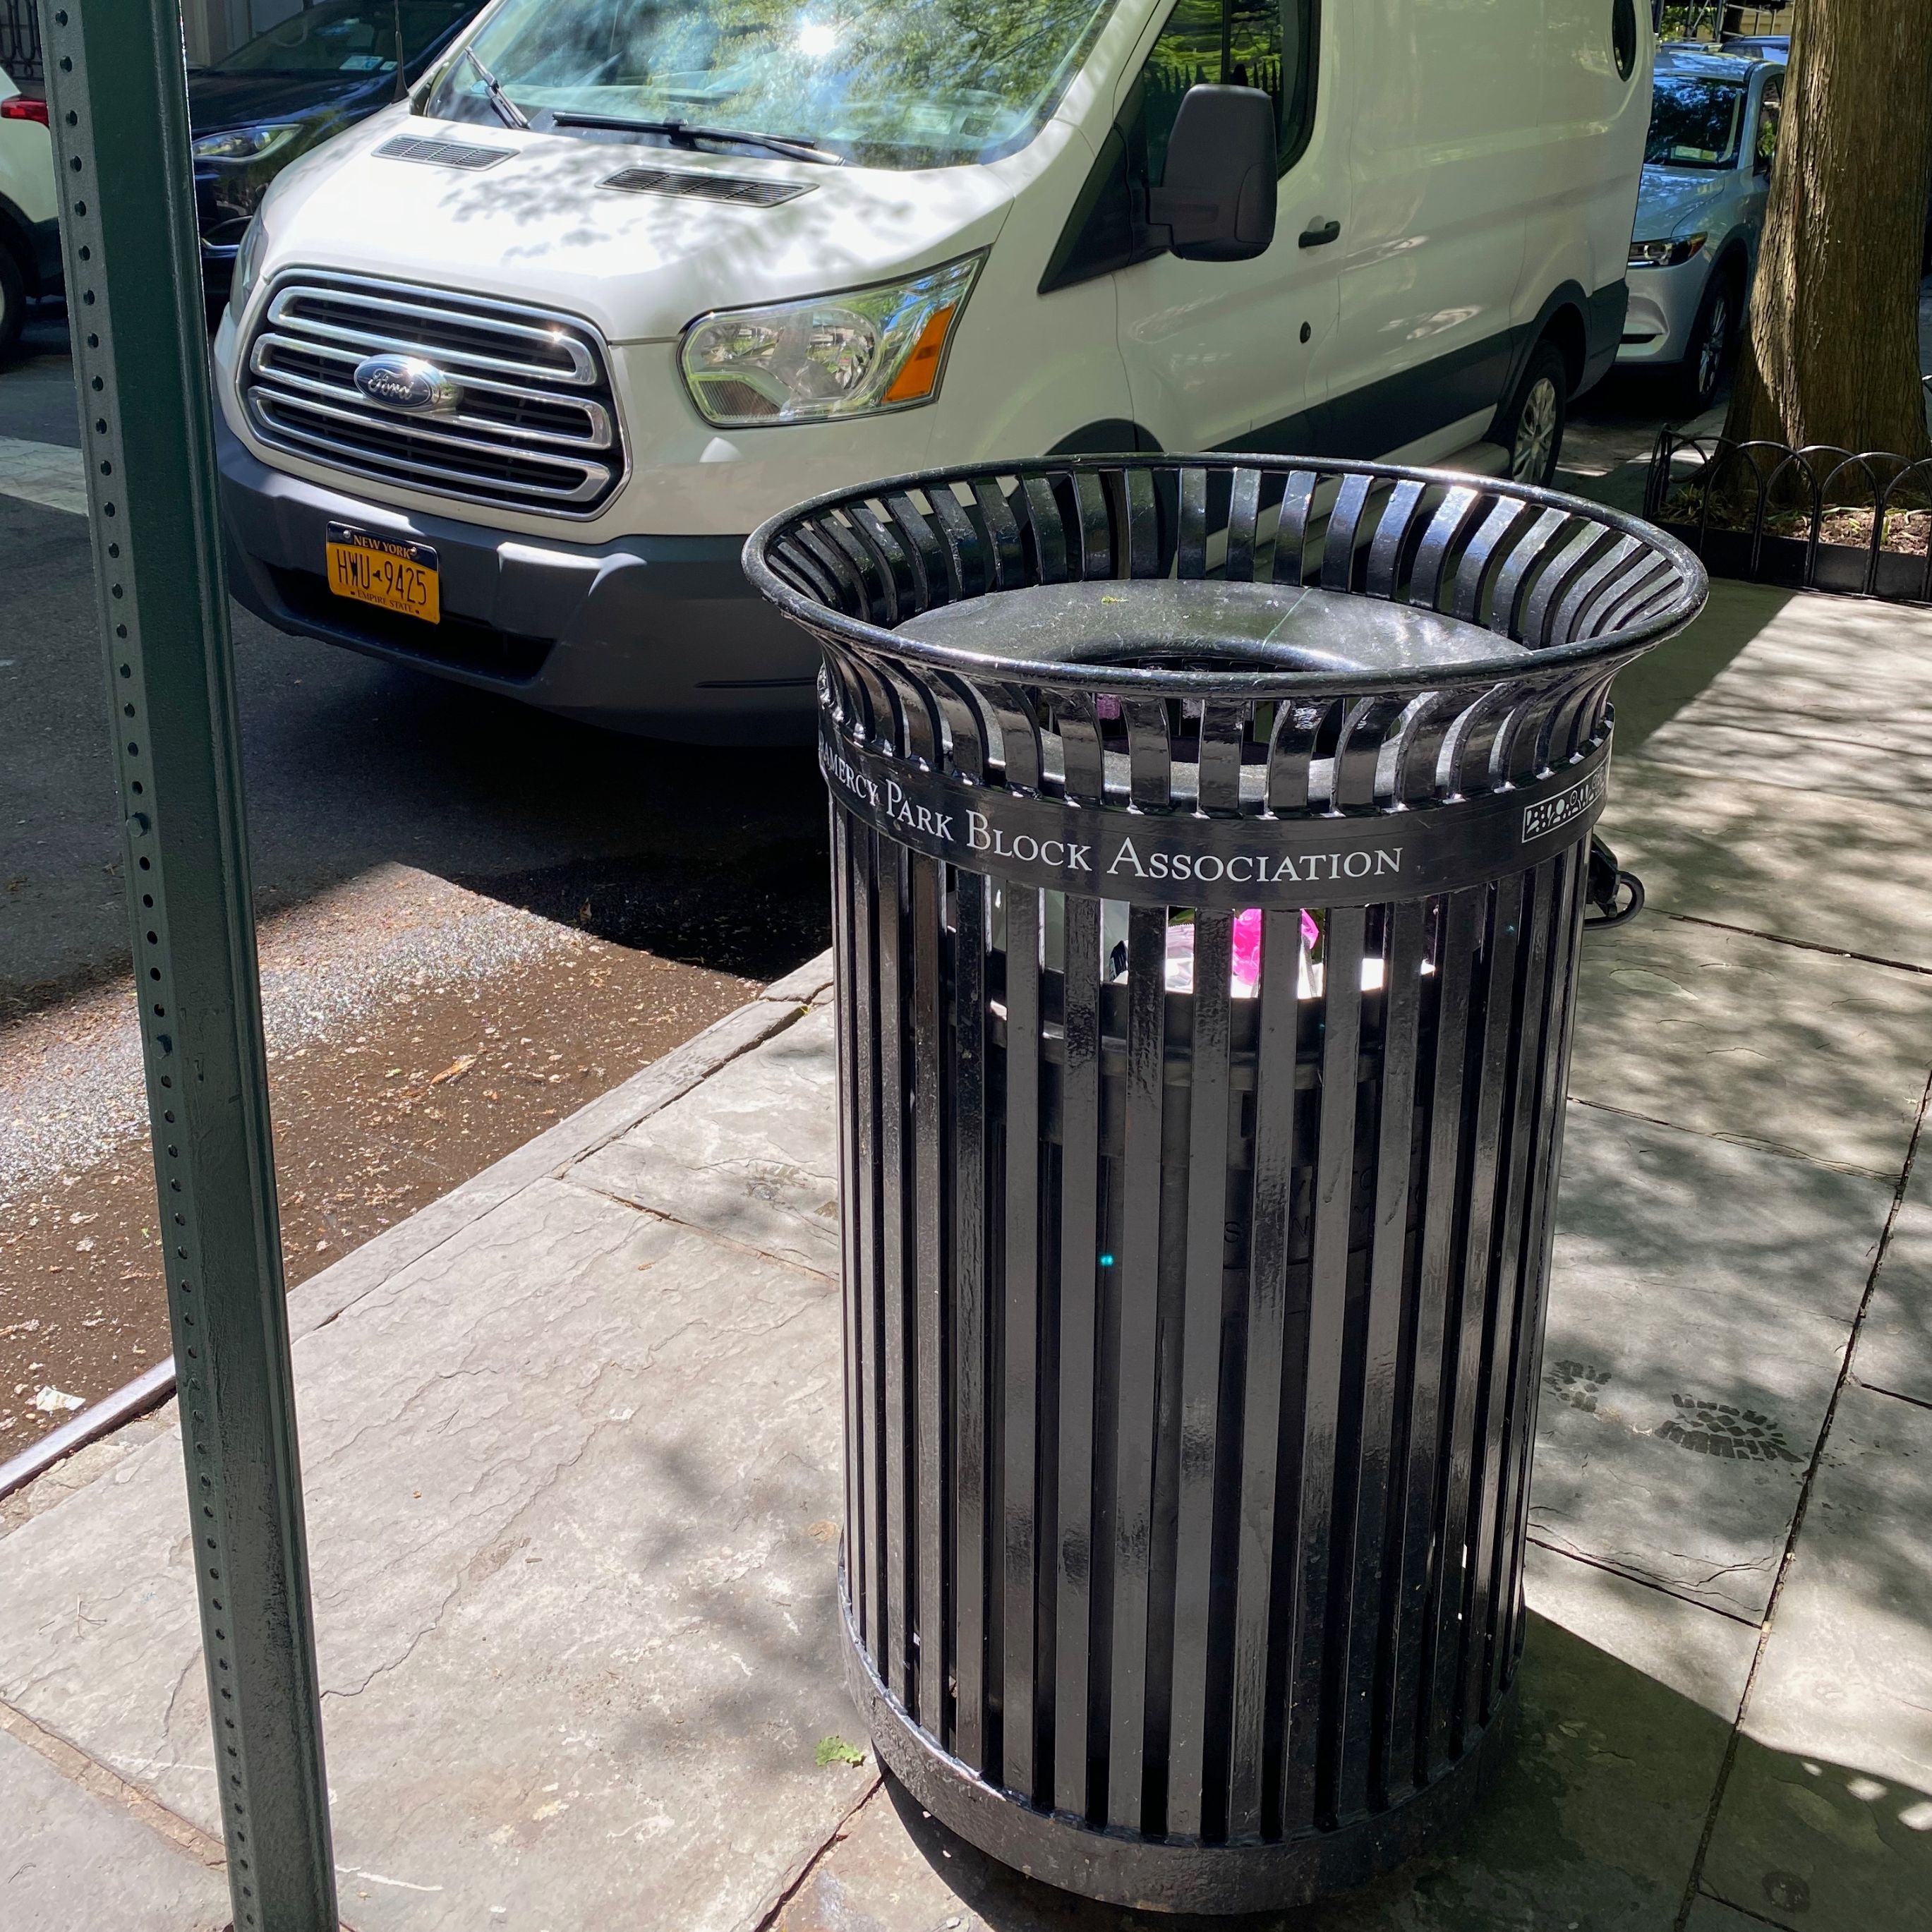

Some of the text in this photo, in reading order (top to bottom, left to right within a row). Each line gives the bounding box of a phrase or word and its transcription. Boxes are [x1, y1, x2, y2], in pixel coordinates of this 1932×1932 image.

[368, 368, 415, 400] Ford
[354, 534, 411, 560] NEW YORK
[384, 560, 427, 605] 9425
[357, 589, 414, 613] EMPIRE STATE
